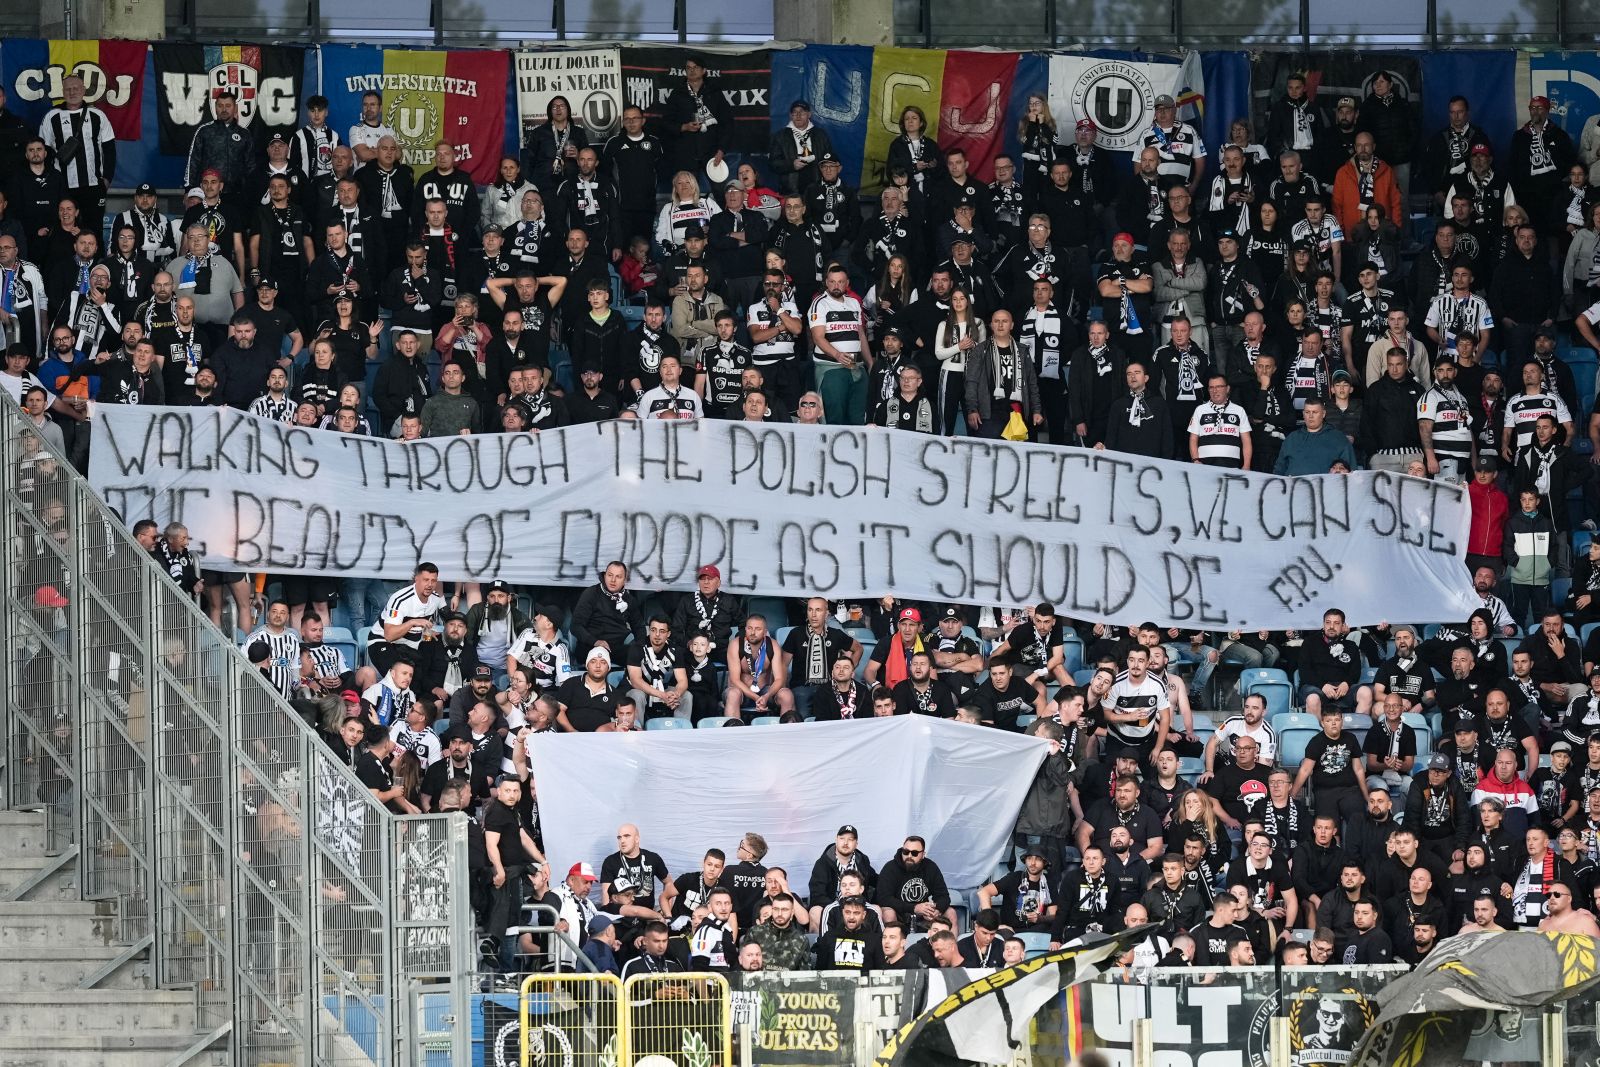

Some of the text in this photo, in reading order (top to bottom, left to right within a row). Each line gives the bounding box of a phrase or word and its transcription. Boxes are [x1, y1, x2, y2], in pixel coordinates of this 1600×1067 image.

[517, 55, 614, 72] CLUJUL DOAR in
[345, 73, 477, 98] UNIVERSITATEA
[550, 75, 562, 92] si
[566, 73, 619, 91] NEGRU
[1080, 64, 1146, 87] UNIVERSITATEA
[1143, 88, 1153, 111] CLUJ
[588, 99, 611, 127] U
[1094, 86, 1133, 130] U
[399, 108, 424, 138] U
[458, 116, 469, 126] 19
[1099, 136, 1126, 146] 1919
[401, 144, 472, 166] NAPCA
[672, 209, 708, 219] SUPERBET
[340, 428, 570, 492] THROUGH
[596, 419, 702, 484] THE
[1258, 475, 1351, 540] CAN
[1370, 470, 1463, 556] SEE
[231, 489, 438, 572] BEAUTY
[461, 509, 531, 578] OF
[557, 508, 759, 591] EUROPE
[777, 520, 841, 593] AS
[930, 529, 1136, 616] SHOULD
[776, 992, 841, 1013] YOUNG,
[777, 1013, 838, 1031] PROUD,
[760, 1030, 840, 1052] ULTRAS
